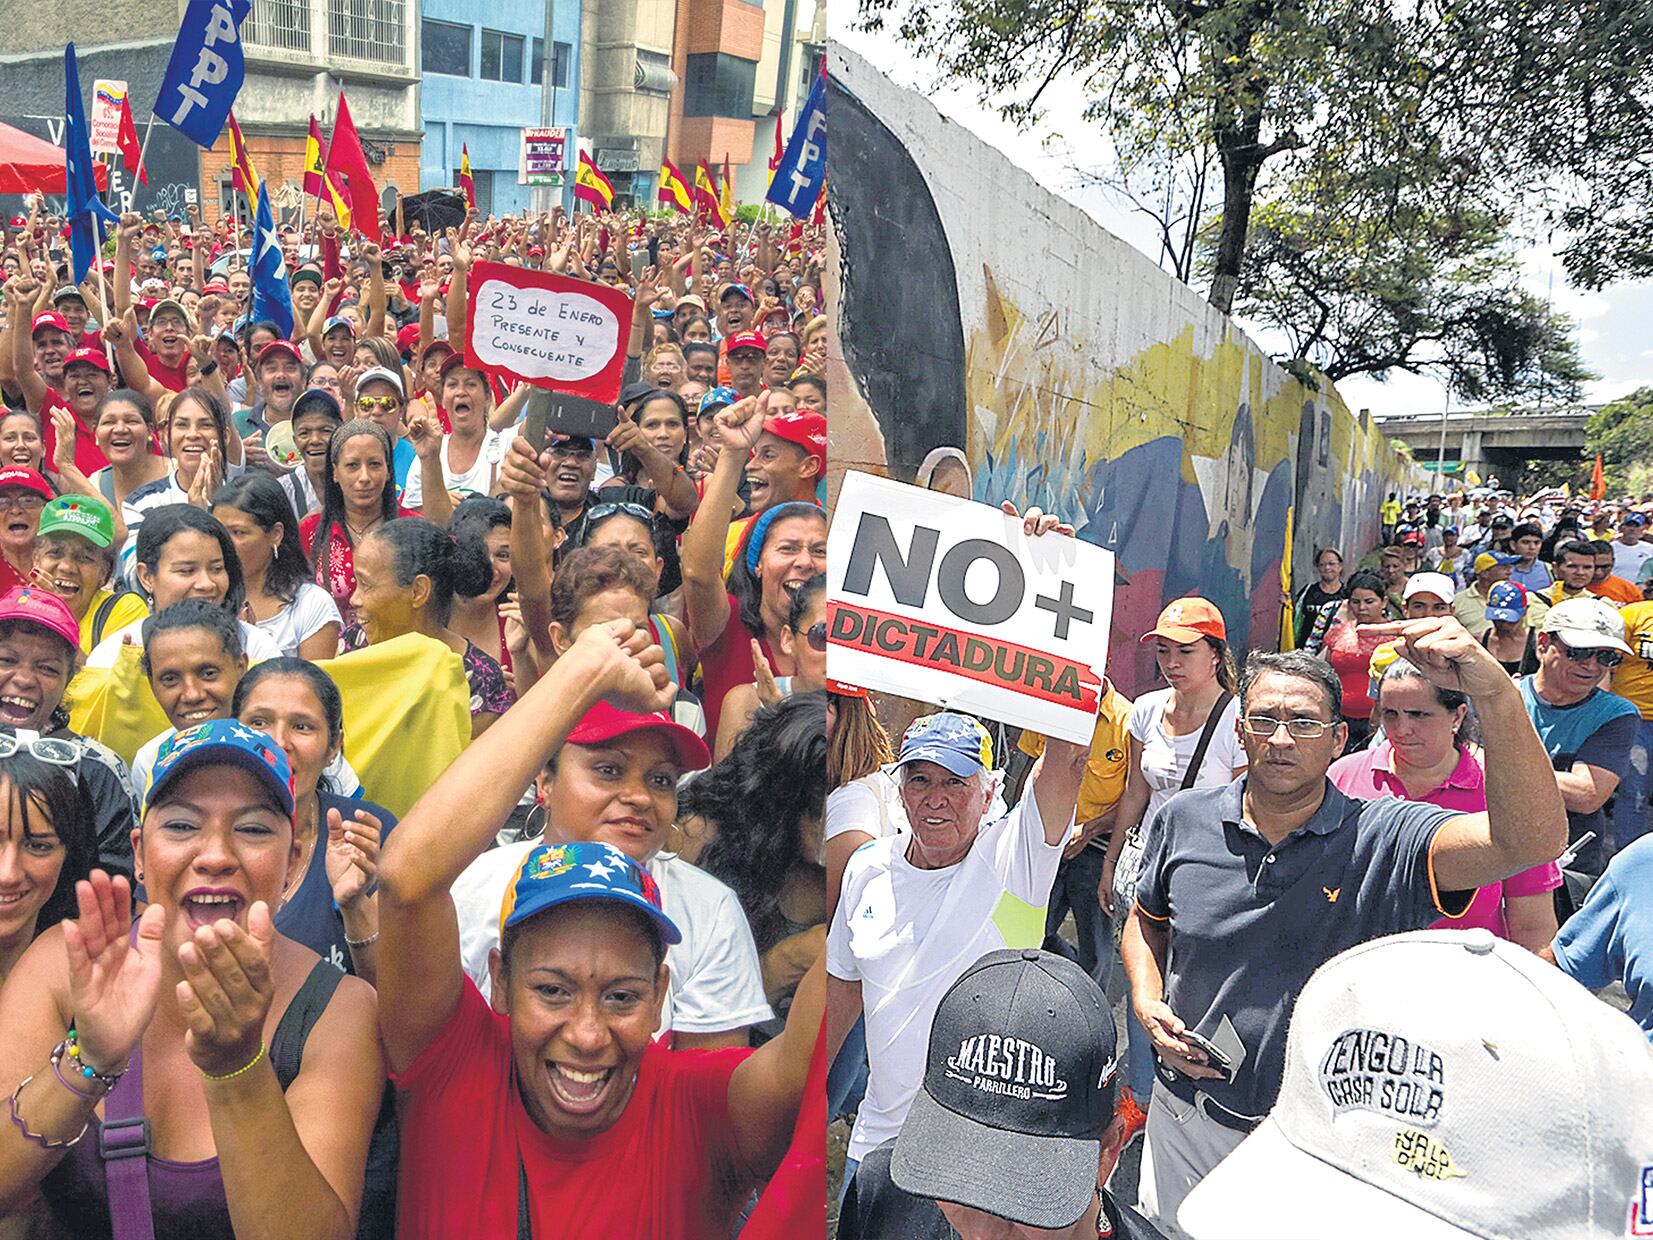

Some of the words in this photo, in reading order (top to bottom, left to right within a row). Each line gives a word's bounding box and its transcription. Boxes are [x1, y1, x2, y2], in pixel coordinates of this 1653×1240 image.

[171, 4, 237, 125] PPT
[491, 291, 517, 311] 23
[528, 299, 547, 317] de
[558, 303, 603, 326] ENERO
[491, 314, 560, 342] PRESENTE
[491, 336, 585, 367] CONSECUENTE
[830, 607, 1082, 701] DICTADURA
[956, 1033, 1056, 1087] MAESTRO
[1323, 1030, 1409, 1076] TENGO
[1413, 1045, 1444, 1084] LA
[972, 1075, 1031, 1100] PARRILLERO
[1327, 1076, 1374, 1107] CASA
[1380, 1078, 1444, 1120] SOLA
